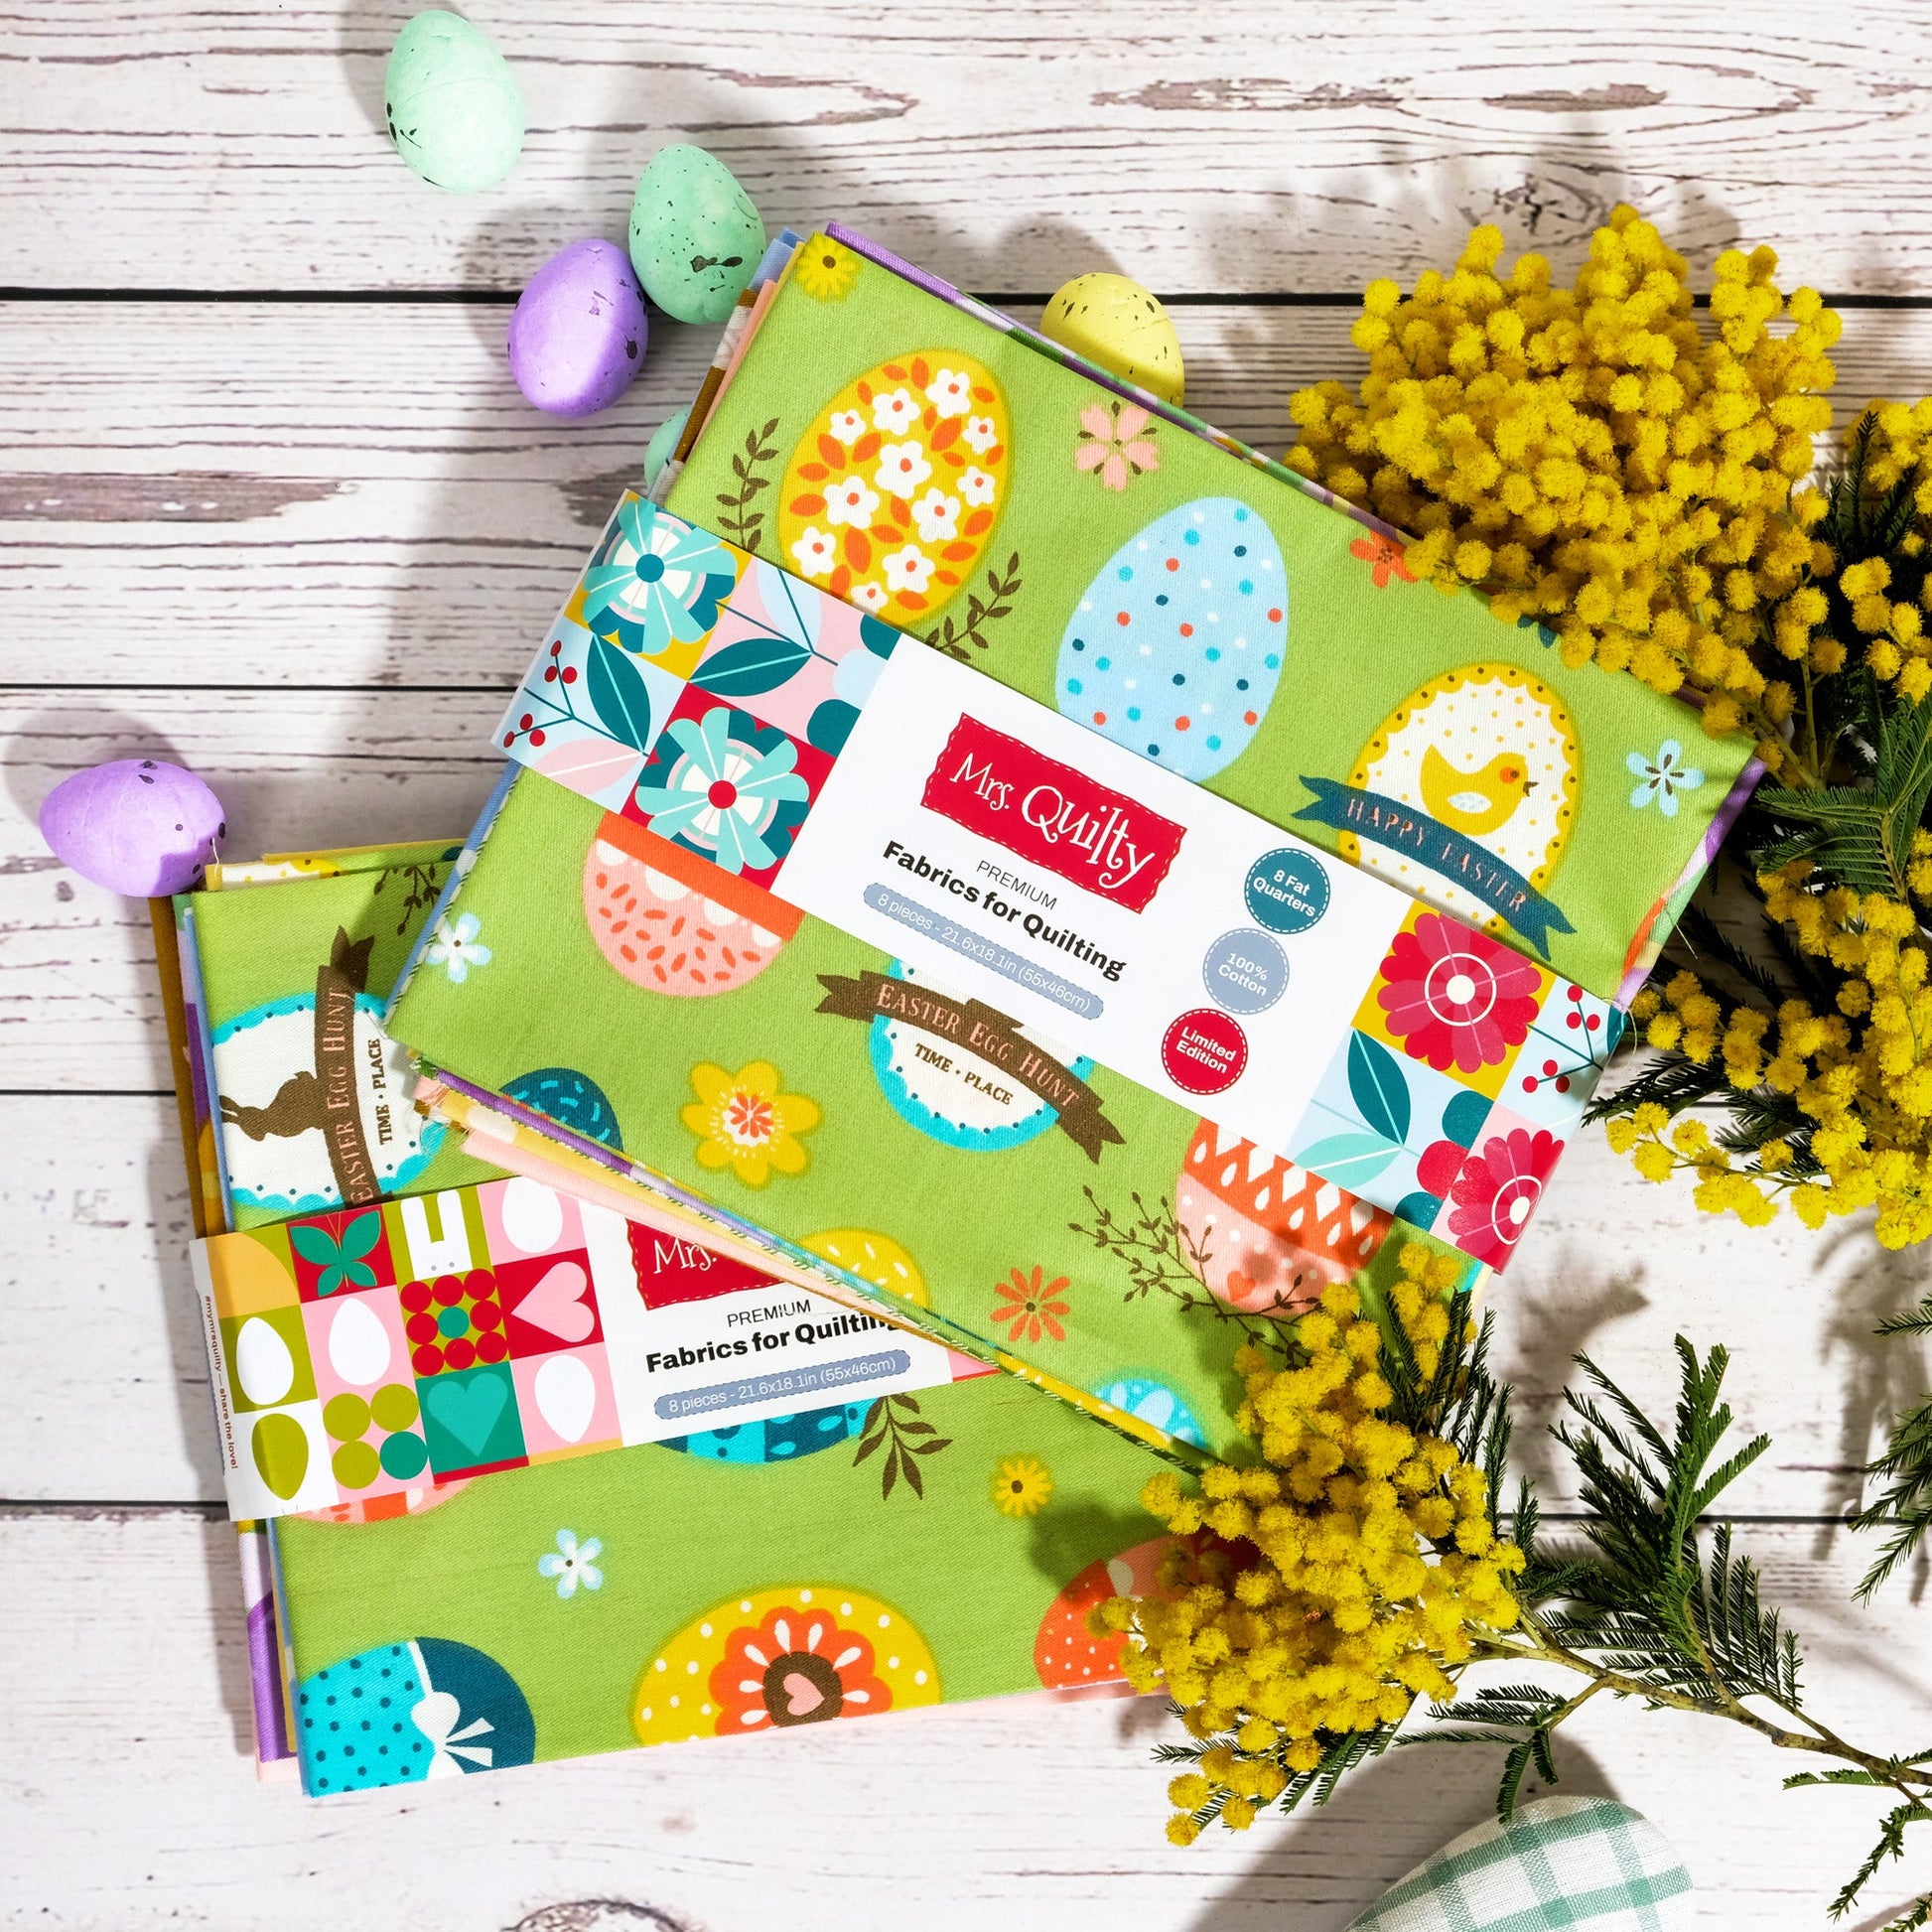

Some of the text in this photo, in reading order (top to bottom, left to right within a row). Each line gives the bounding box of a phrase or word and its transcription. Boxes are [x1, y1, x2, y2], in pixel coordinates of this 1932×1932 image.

[949, 753, 1155, 890] Mrs. Quilty
[1346, 798, 1527, 912] HAPPY EASTER
[976, 860, 1058, 910] PREMIUM
[1253, 876, 1316, 918] Quarters
[1273, 869, 1310, 897] 8 Fat
[883, 841, 1127, 983] Fabrics for Quilting
[877, 893, 888, 907] 8
[888, 899, 933, 931] pieces
[941, 925, 1017, 974] 21.6x18.1in
[1018, 962, 1092, 1013] (55x46cm)
[1227, 952, 1268, 982] 100%
[1217, 963, 1267, 997] Cotton
[367, 1038, 385, 1090] PLACE
[877, 983, 1082, 1108] EASTER EGG HUNT
[1175, 1041, 1228, 1074] Edition
[1181, 1026, 1237, 1061] Limited
[323, 987, 373, 1205] EASTER EGG HUNT
[914, 1043, 953, 1073] TIME
[963, 1072, 1014, 1106] PLACE
[375, 1104, 393, 1146] TIME
[727, 1300, 812, 1328] PREMIUM
[645, 1313, 899, 1373] Fabrics for Quiltin
[218, 1387, 229, 1421] share
[668, 1400, 679, 1413] 8
[680, 1391, 727, 1414] pieces
[738, 1372, 818, 1400] 21.6x18.1in
[820, 1356, 897, 1386] (55x46cm)
[223, 1420, 232, 1442] the
